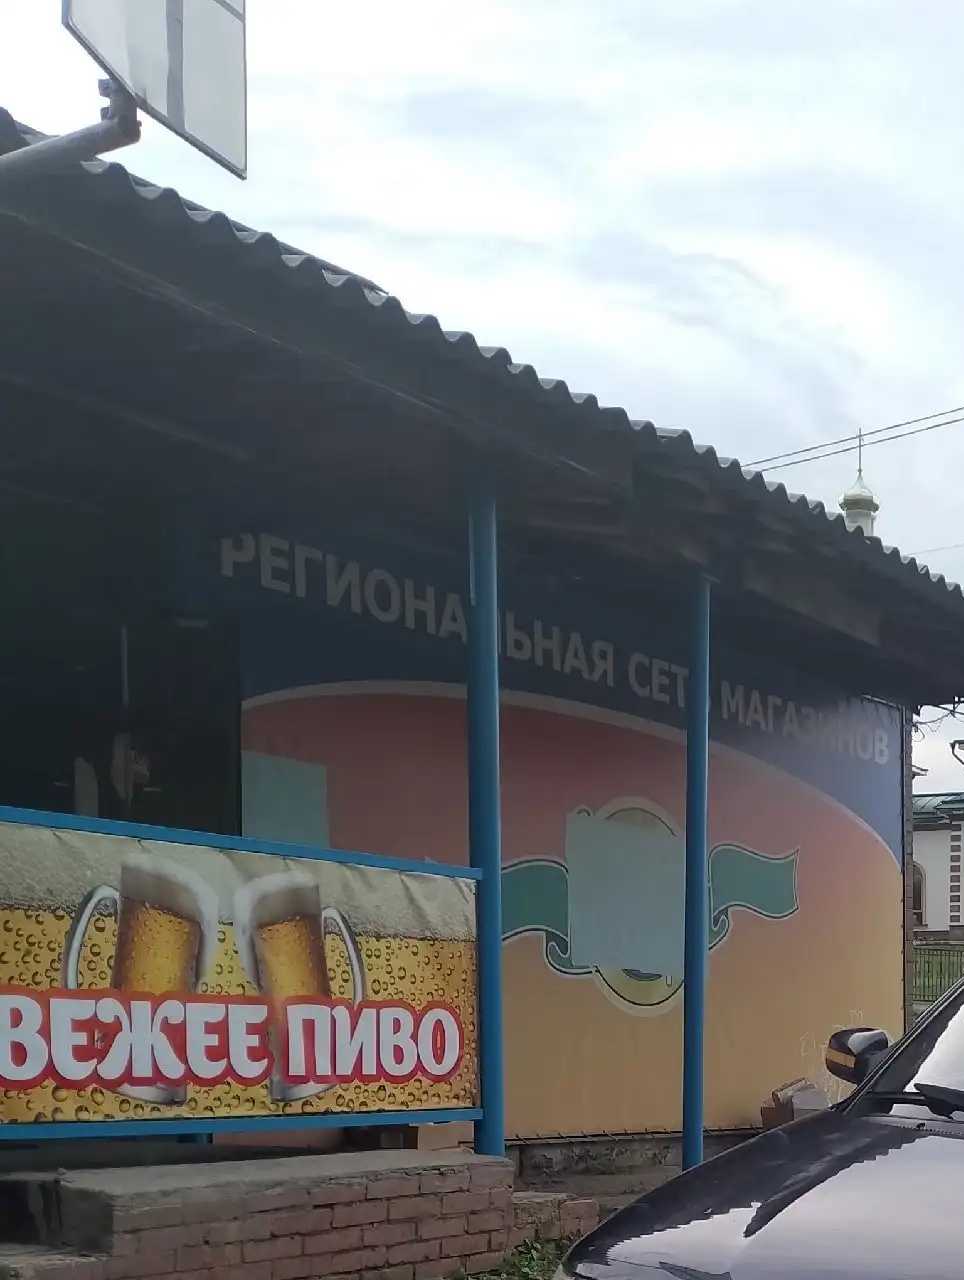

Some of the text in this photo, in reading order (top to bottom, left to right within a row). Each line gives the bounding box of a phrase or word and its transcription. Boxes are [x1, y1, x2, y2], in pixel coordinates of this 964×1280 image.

[220, 532, 890, 766] РЕГИОНАЬНАЯ СЕТ МАГАЗИНОВ
[287, 1003, 460, 1078] ПИВО
